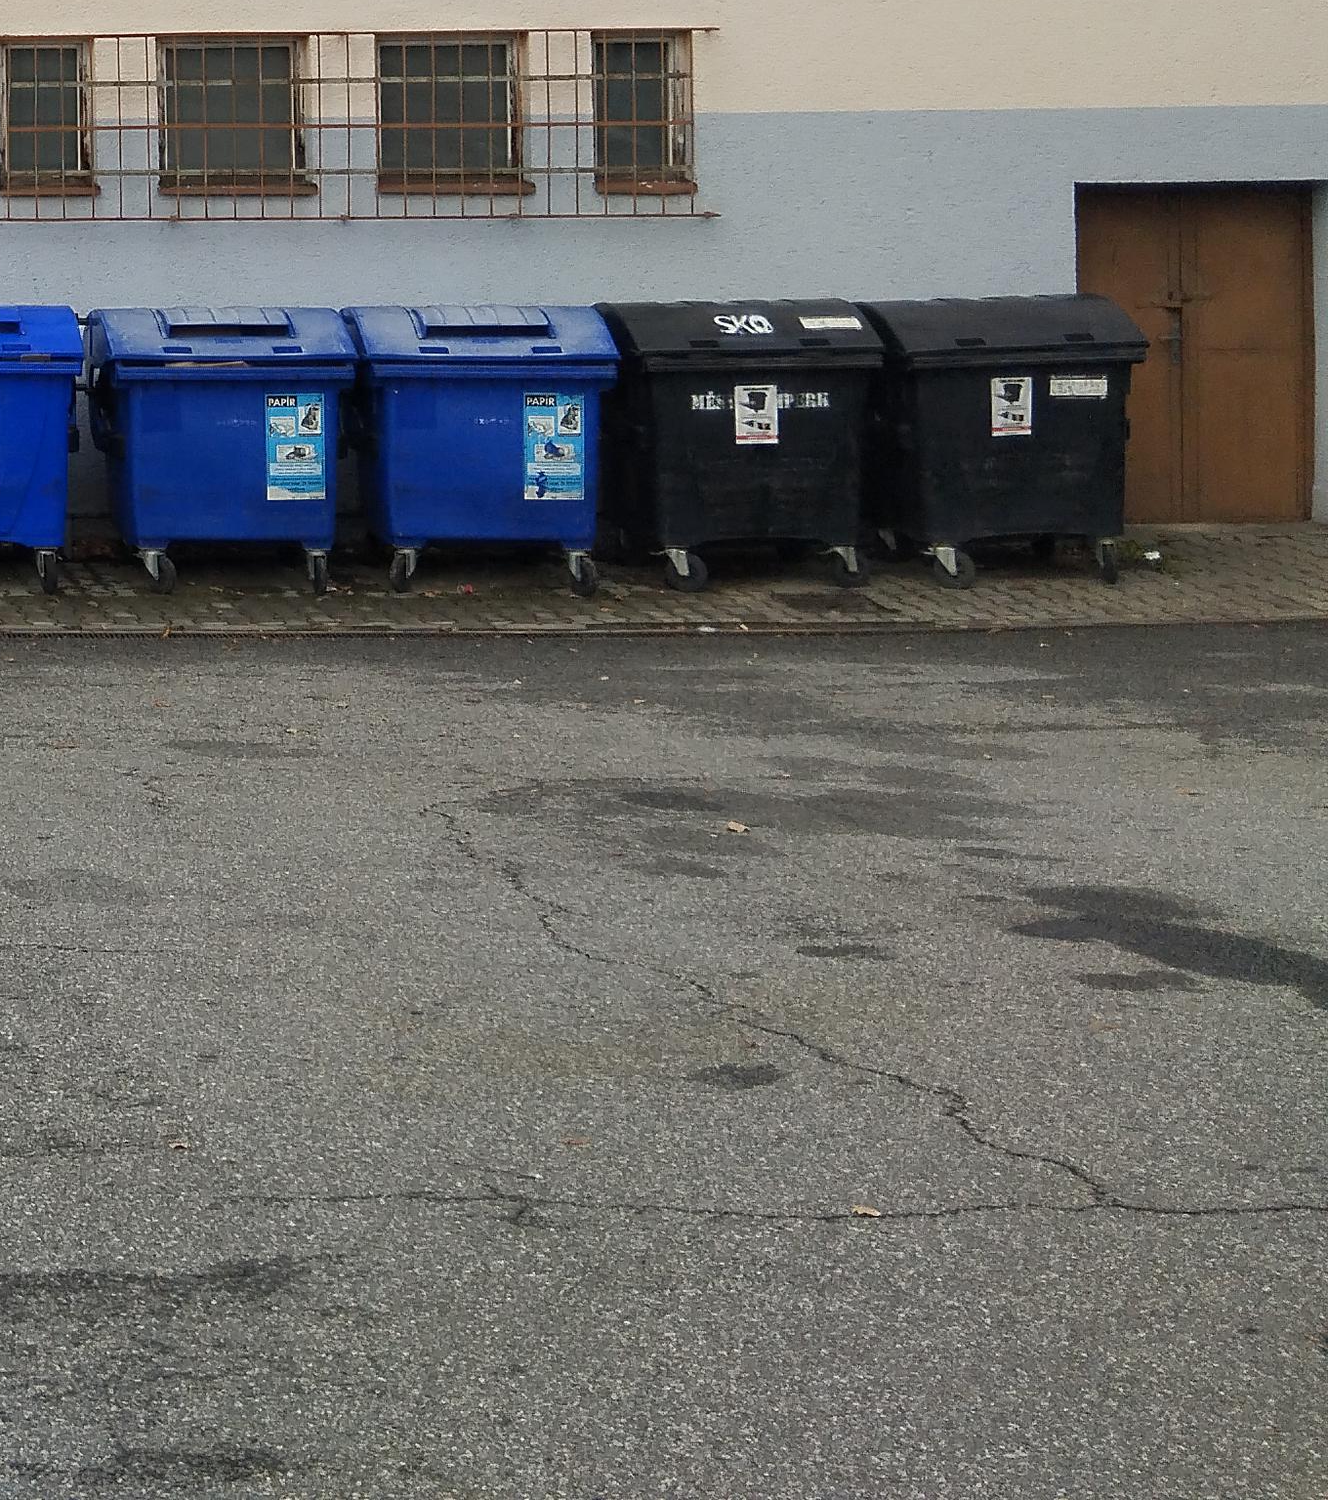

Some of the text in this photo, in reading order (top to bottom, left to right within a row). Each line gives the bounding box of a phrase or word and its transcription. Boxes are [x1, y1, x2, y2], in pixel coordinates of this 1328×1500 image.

[713, 314, 775, 334] SKO
[268, 396, 296, 407] PAPÍR
[526, 396, 555, 406] PAPÍR
